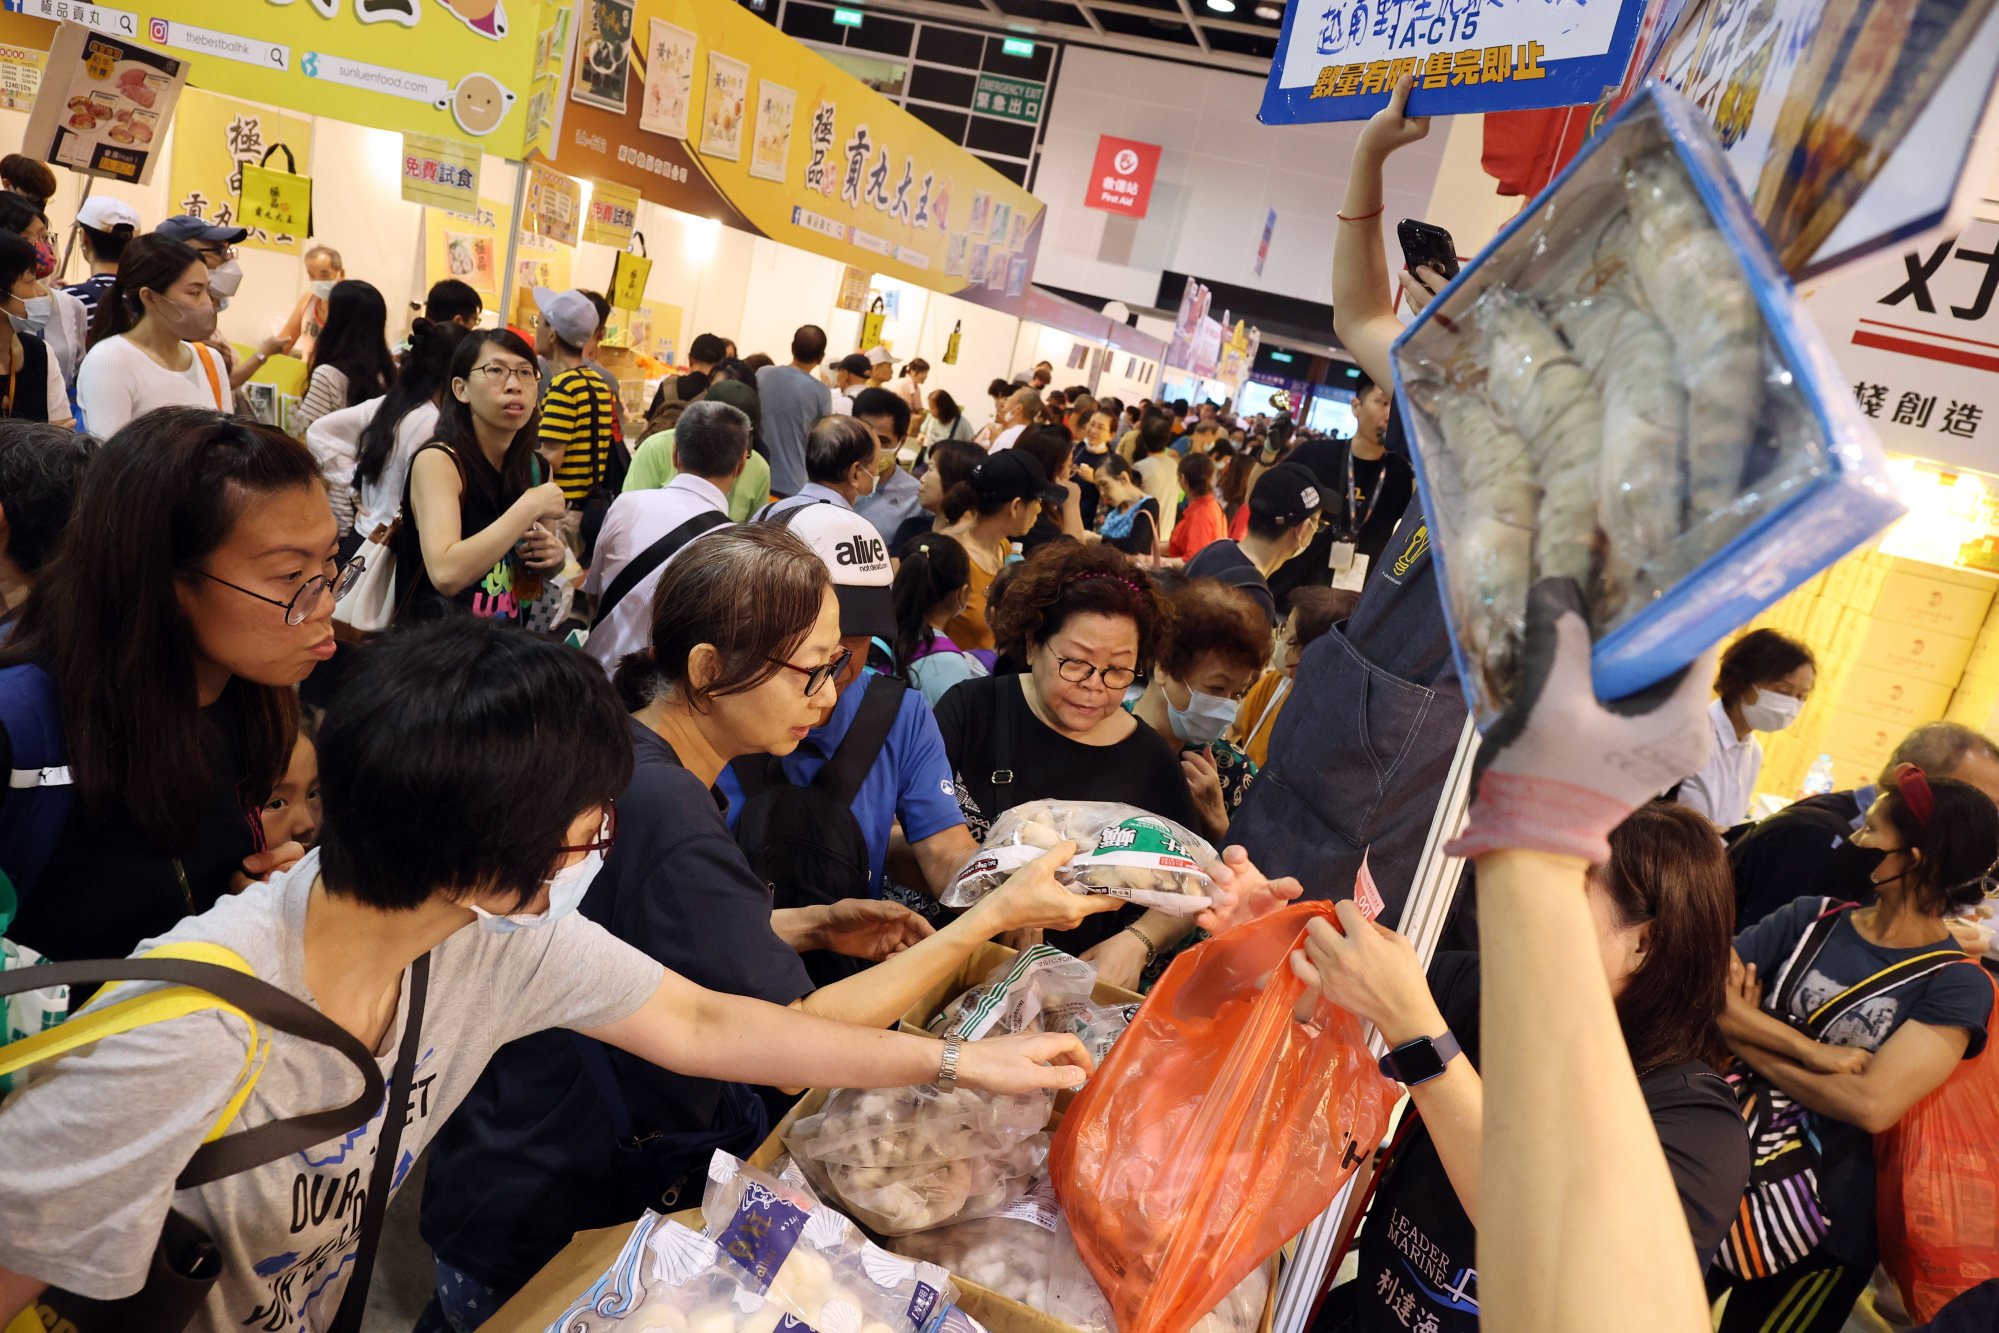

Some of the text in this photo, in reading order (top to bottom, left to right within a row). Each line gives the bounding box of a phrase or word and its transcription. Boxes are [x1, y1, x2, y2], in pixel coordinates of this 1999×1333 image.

[185, 31, 250, 56] thebestballhk
[338, 65, 429, 95] sunluenfood.com
[979, 77, 1043, 100] EMERGENCY EXIT
[806, 104, 835, 187] 極品
[404, 155, 474, 192] 免費試食
[844, 128, 934, 223] 貢丸大王
[591, 201, 636, 230] 免費試食
[1119, 196, 1135, 207] Aid
[835, 534, 885, 566] alive
[1391, 1207, 1451, 1275] LEADER
[1387, 1228, 1447, 1289] MARINE
